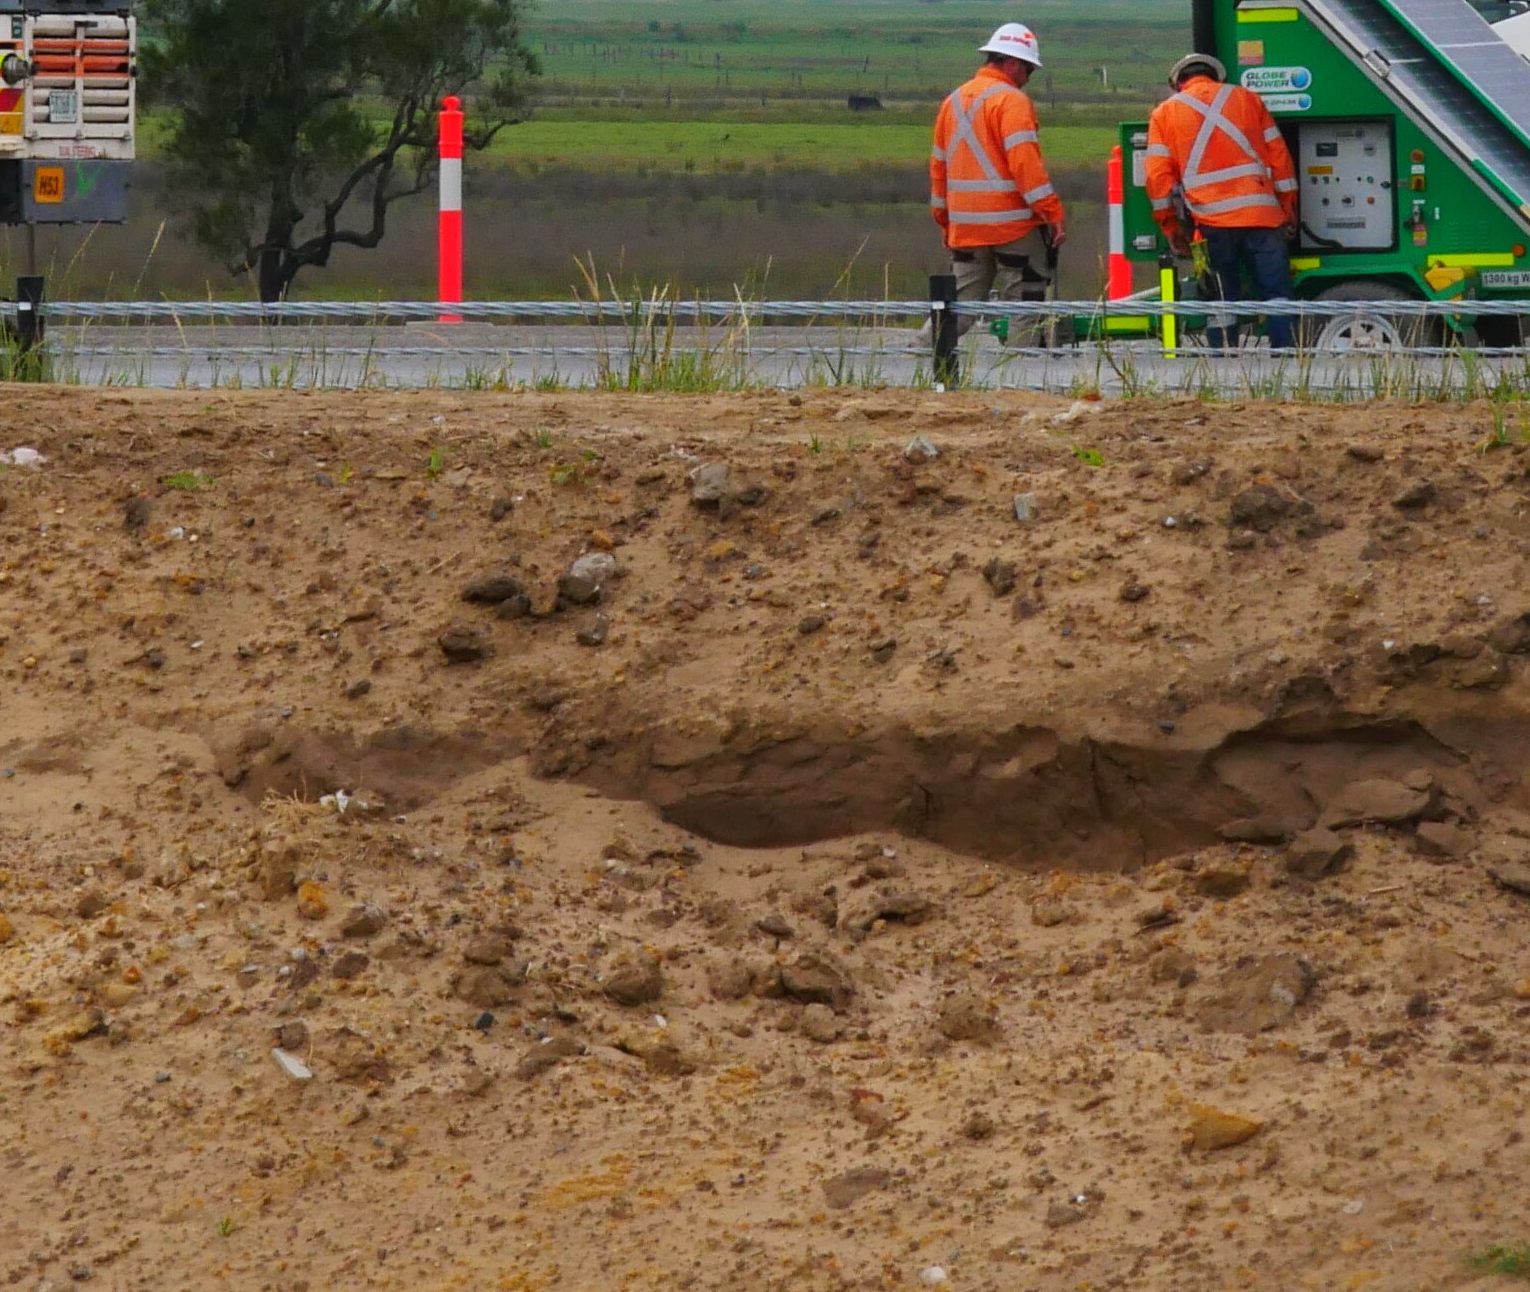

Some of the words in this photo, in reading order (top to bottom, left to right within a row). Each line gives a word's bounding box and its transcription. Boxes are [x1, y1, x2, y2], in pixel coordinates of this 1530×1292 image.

[1246, 71, 1286, 80] GLOBE
[1246, 79, 1289, 88] POWER
[1483, 273, 1506, 284] 1300
[1507, 274, 1520, 285] kg
